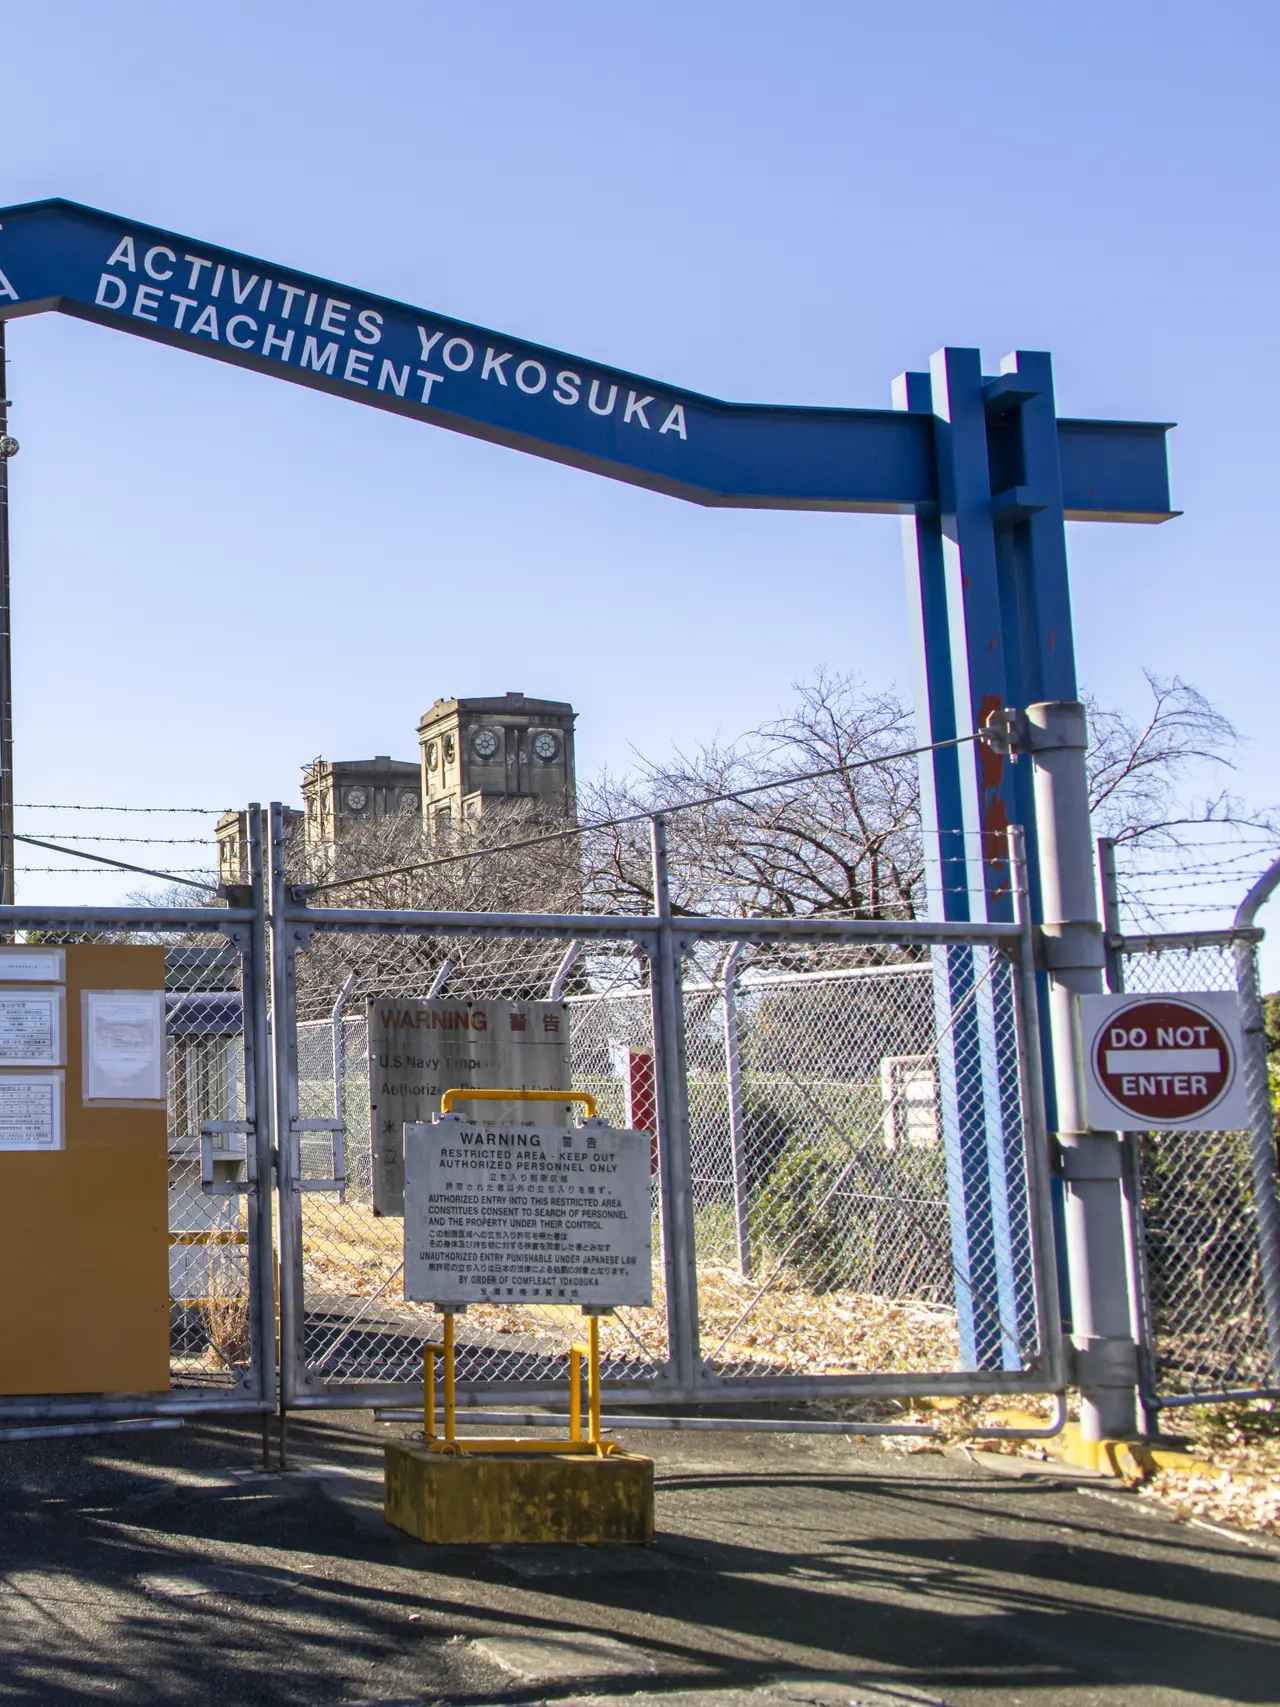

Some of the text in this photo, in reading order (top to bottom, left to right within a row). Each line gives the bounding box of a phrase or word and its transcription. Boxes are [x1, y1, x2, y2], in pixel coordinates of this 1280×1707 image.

[95, 273, 444, 404] DETACHMENT
[106, 235, 385, 346] ACTIVITIES
[417, 325, 688, 440] YOKOSUKA
[380, 1010, 559, 1032] WARNING 警告
[1111, 1026, 1210, 1048] DO NOT
[1122, 1075, 1208, 1096] ENTER
[460, 1132, 596, 1149] WARNING 警告
[441, 1149, 511, 1159] RESTRICTED
[516, 1152, 547, 1160] AREA
[560, 1153, 588, 1161] KEEP
[593, 1154, 615, 1162] OUT
[439, 1160, 618, 1173] AUTHORIZED PERSONNEL ONLY
[428, 1194, 622, 1208] AUTHORIZED ENTRY INTO THIS RESTRICTED AREA
[428, 1206, 628, 1219] CONSTITUES CONSENT TO SEARCH OF PERSONNEL
[429, 1217, 603, 1230] AND THE PROPERTY UNDER THEIR CONTROL
[420, 1252, 637, 1265] UNAUTHORIZED ENTRY PUNISHABLE UNDER JAPANESE LAW
[459, 1275, 599, 1286] BY ORDER OF COMFLEACT YOKOSUKA
